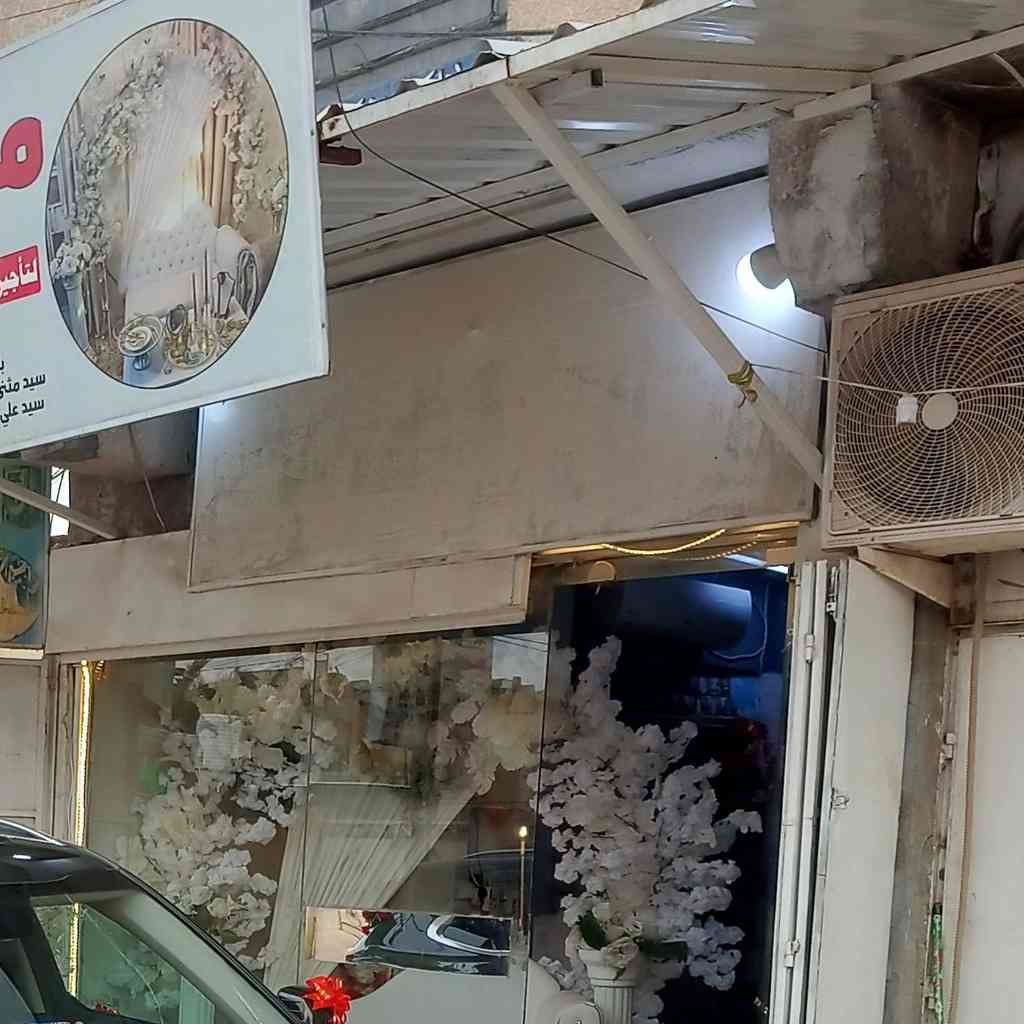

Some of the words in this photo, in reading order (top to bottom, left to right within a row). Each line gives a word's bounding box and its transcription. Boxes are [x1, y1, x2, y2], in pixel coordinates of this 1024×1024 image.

[23, 374, 46, 391] سيد
[0, 401, 19, 427] علي
[21, 400, 45, 416] سيد
